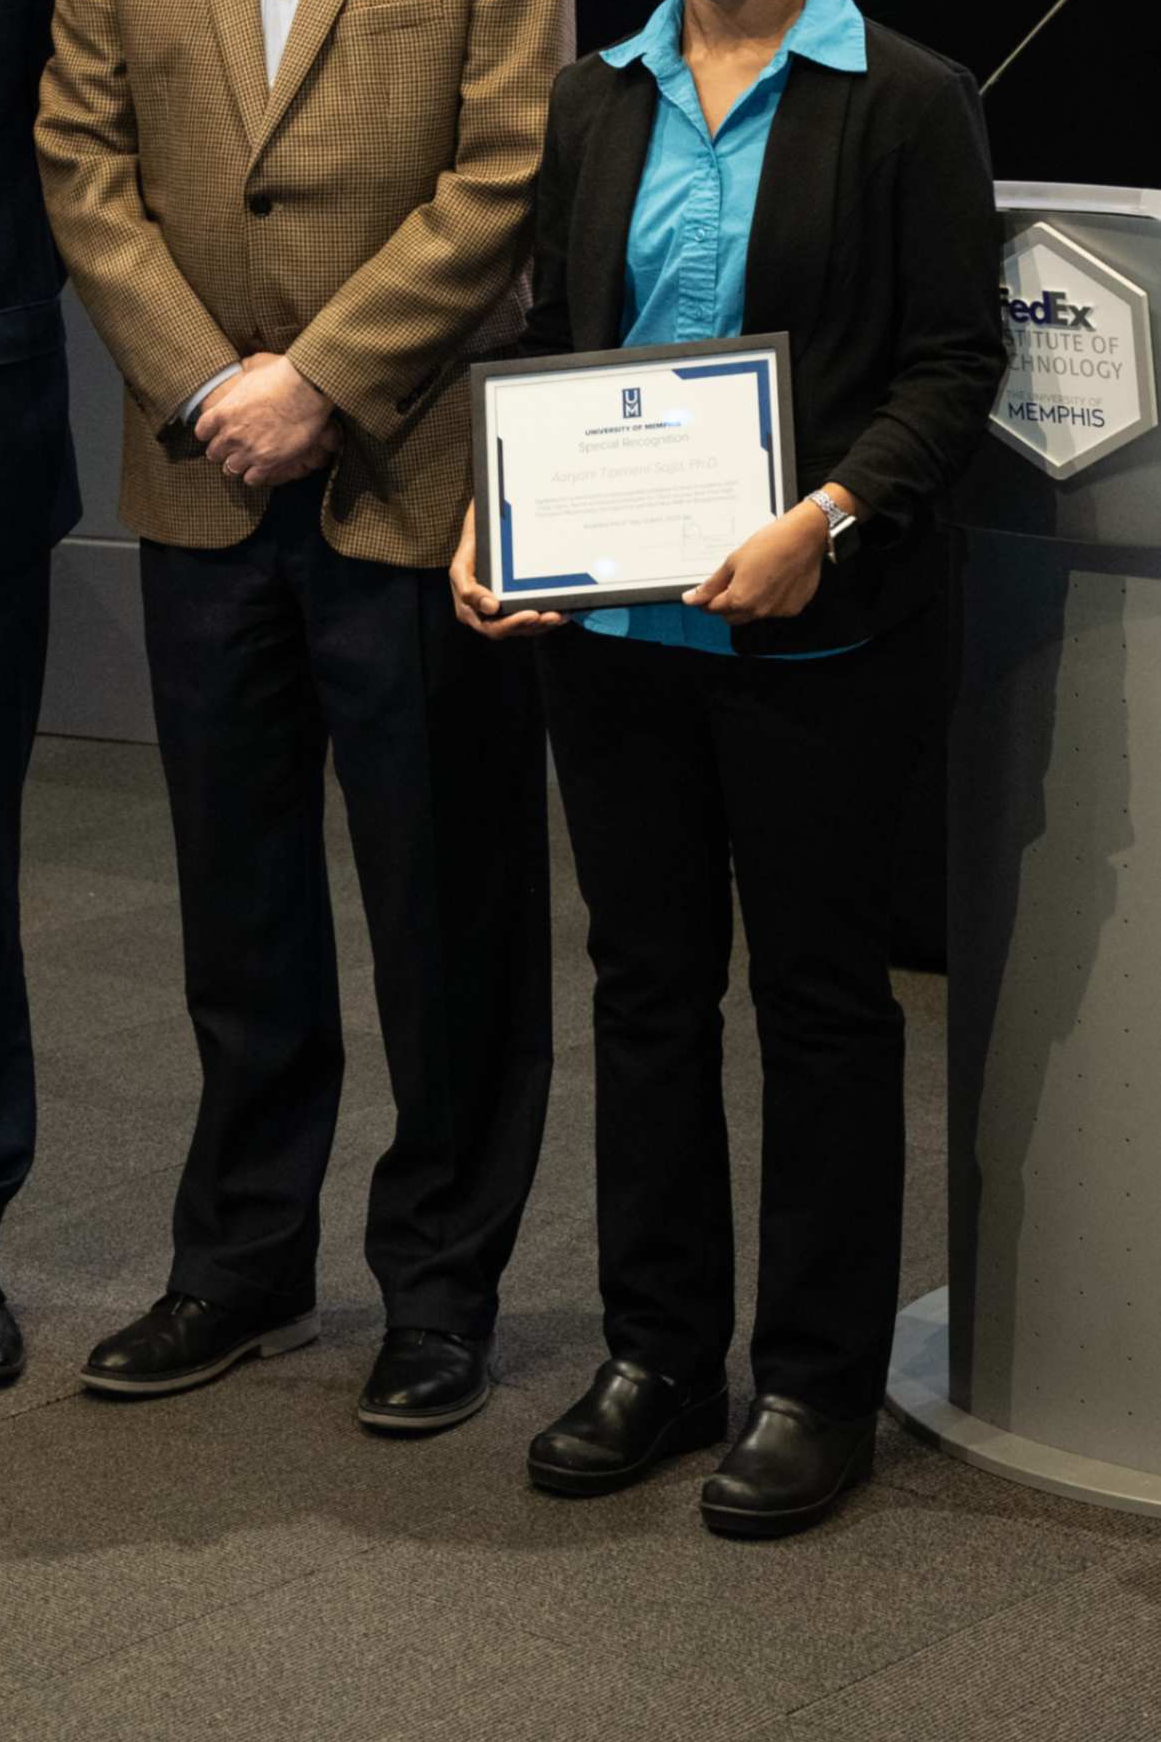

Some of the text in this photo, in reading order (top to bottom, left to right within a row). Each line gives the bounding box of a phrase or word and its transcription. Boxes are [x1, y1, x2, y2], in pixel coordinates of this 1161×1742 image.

[1091, 334, 1120, 356] OF
[1027, 391, 1086, 405] UNIVERSITY
[1088, 396, 1103, 407] OF
[1007, 401, 1105, 428] MEMPHIS
[584, 425, 631, 436] UNIVERSITY
[577, 432, 690, 454] Special Recognition
